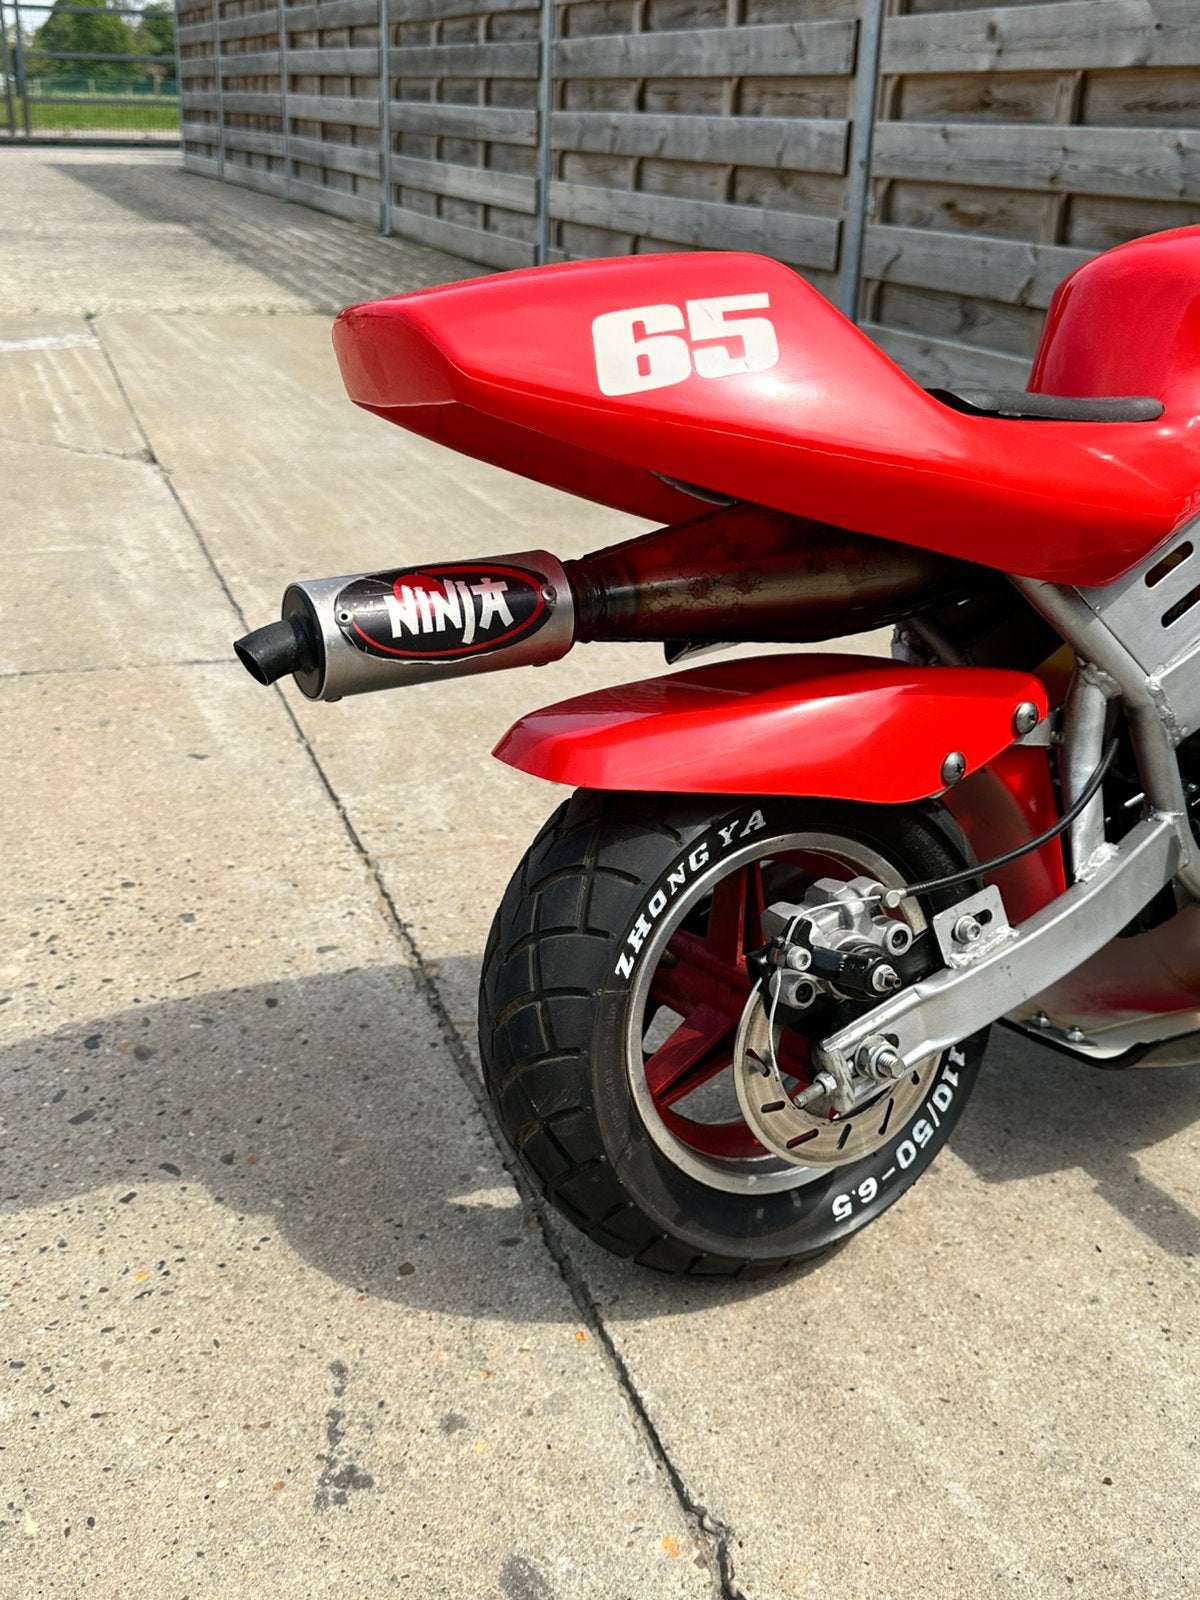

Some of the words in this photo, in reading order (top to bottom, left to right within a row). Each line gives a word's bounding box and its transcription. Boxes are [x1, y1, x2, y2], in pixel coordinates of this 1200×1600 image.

[592, 292, 779, 396] 65
[384, 577, 514, 644] NINJA
[614, 842, 710, 980] ZHONG
[718, 809, 767, 848] YA
